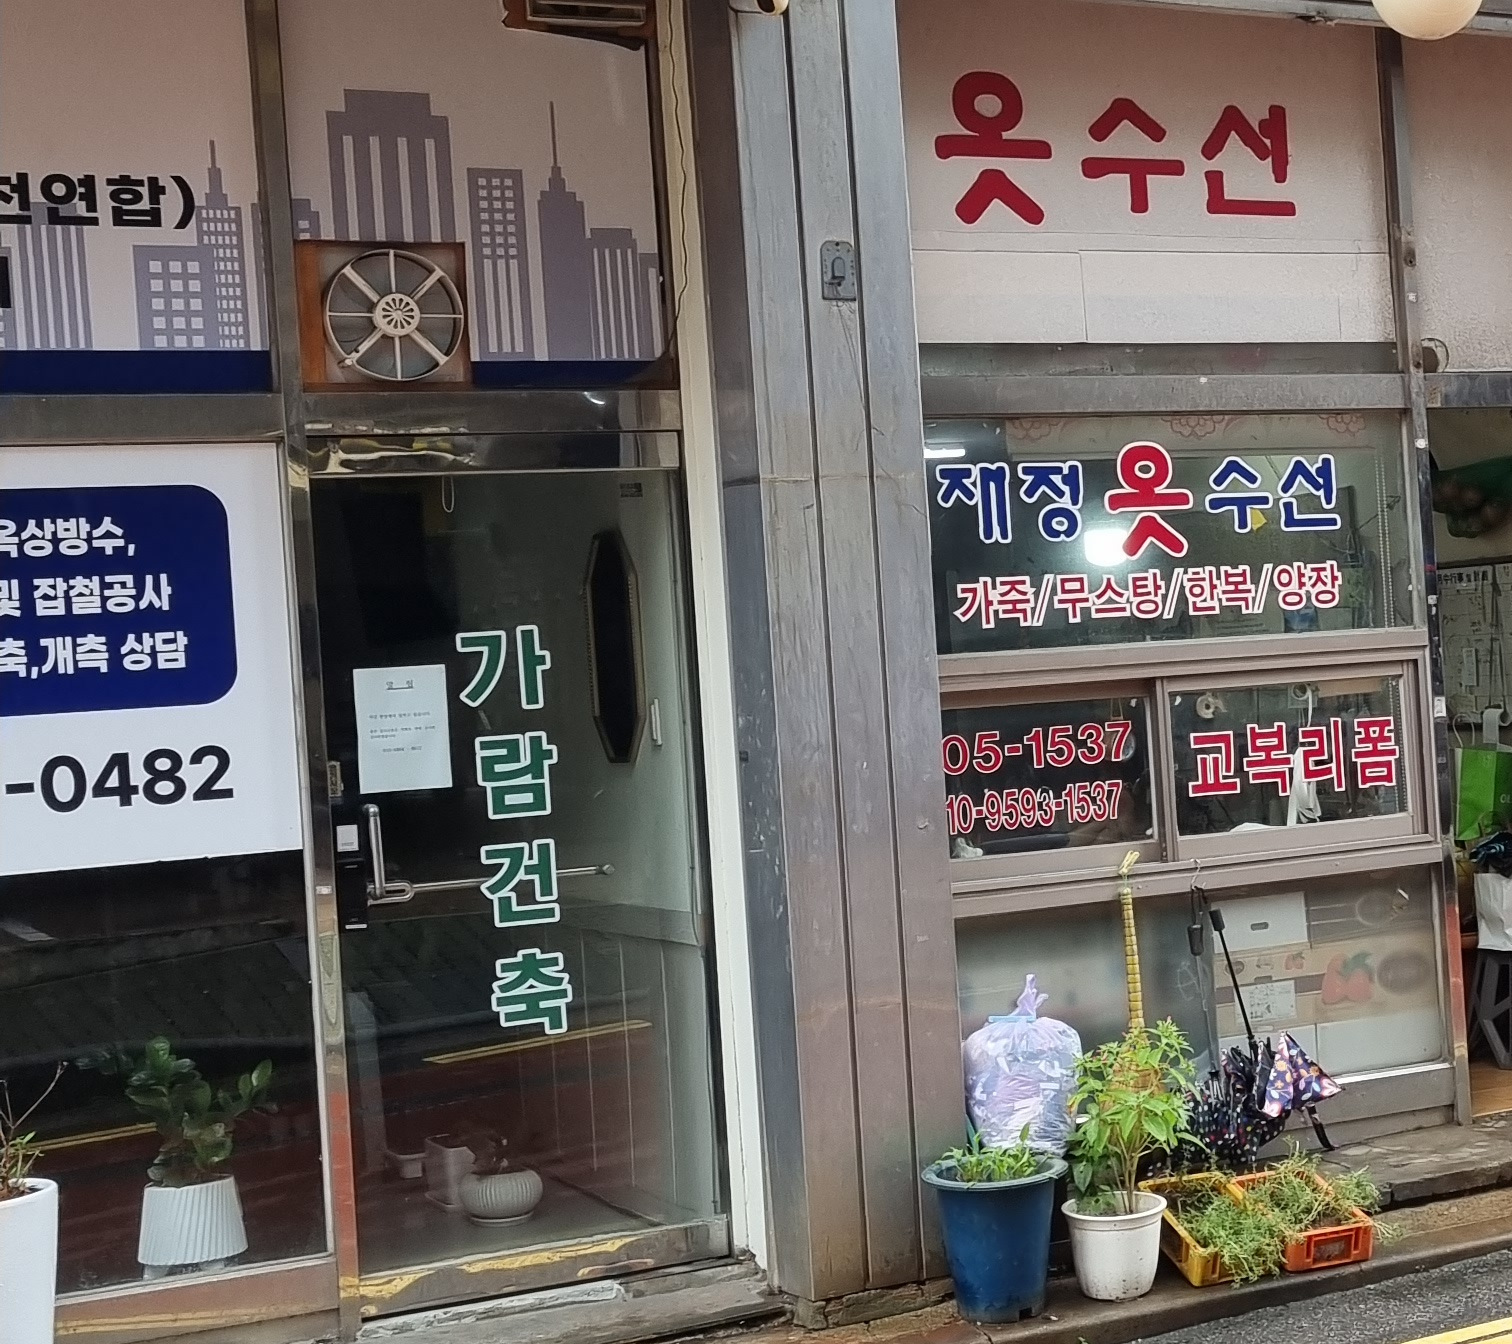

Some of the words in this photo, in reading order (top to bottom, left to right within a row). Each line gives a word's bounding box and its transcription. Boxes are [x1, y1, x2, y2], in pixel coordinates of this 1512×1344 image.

[936, 460, 1084, 544] 재정
[33, 573, 172, 616] 잡철공사
[120, 630, 189, 671] 상담
[4, 744, 235, 814] -0482
[941, 720, 1132, 775] 05-1537
[1187, 716, 1400, 798] 교복리폼
[456, 624, 573, 1036] 가람건축
[945, 779, 1123, 836] 10-9593-1537
